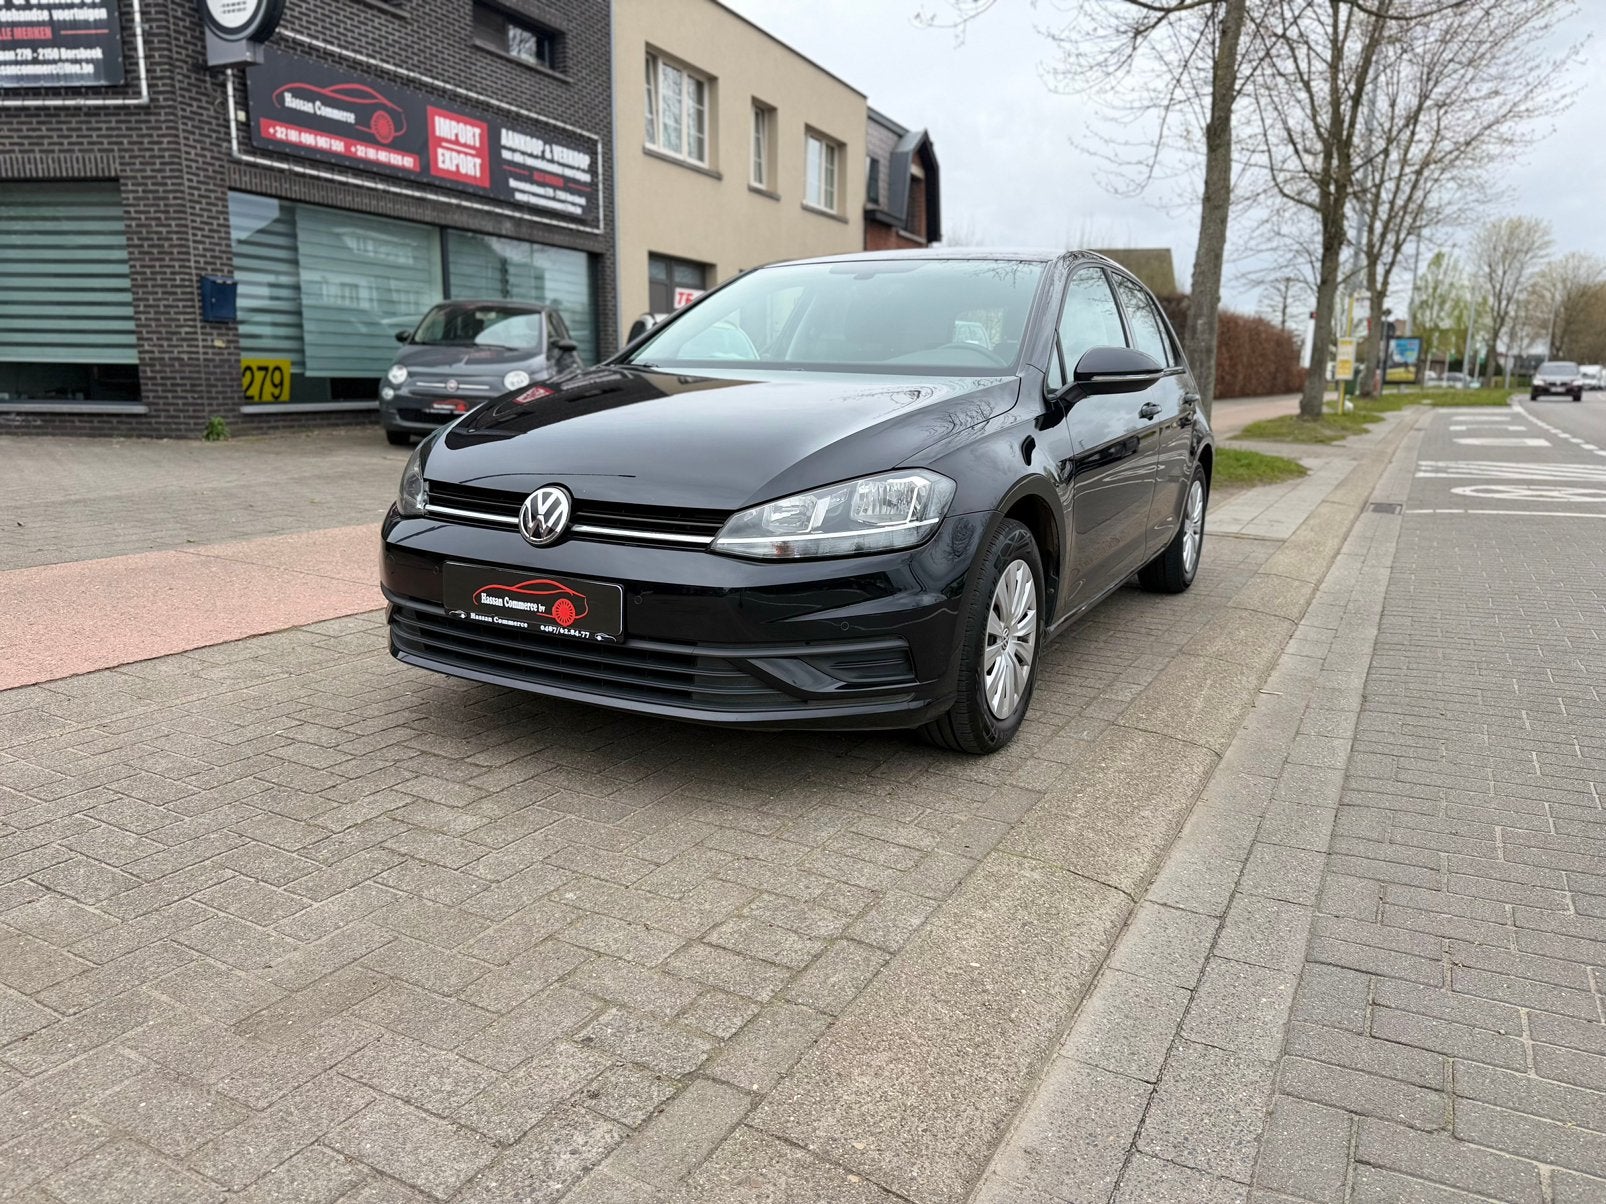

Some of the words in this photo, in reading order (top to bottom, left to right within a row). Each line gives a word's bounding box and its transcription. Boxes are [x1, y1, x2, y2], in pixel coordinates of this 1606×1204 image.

[51, 7, 108, 21] voertuigen
[13, 26, 53, 40] MERKEN
[15, 47, 32, 61] 279
[37, 47, 59, 60] 2150
[284, 91, 314, 114] Hassan
[315, 100, 356, 124] Commerce
[275, 125, 287, 140] 32
[434, 115, 482, 148] IMPORT
[500, 127, 545, 157] AANKOOP
[544, 143, 553, 160] &
[551, 143, 592, 171] VERKOOP
[437, 147, 483, 179] EXPORT
[242, 364, 284, 401] 279
[481, 592, 503, 606] Hassan
[503, 597, 538, 612] Commerce
[537, 603, 546, 613] bv
[470, 612, 493, 623] Hassan
[493, 616, 529, 628] Commerce
[540, 624, 590, 639] 0487/62.84.77
